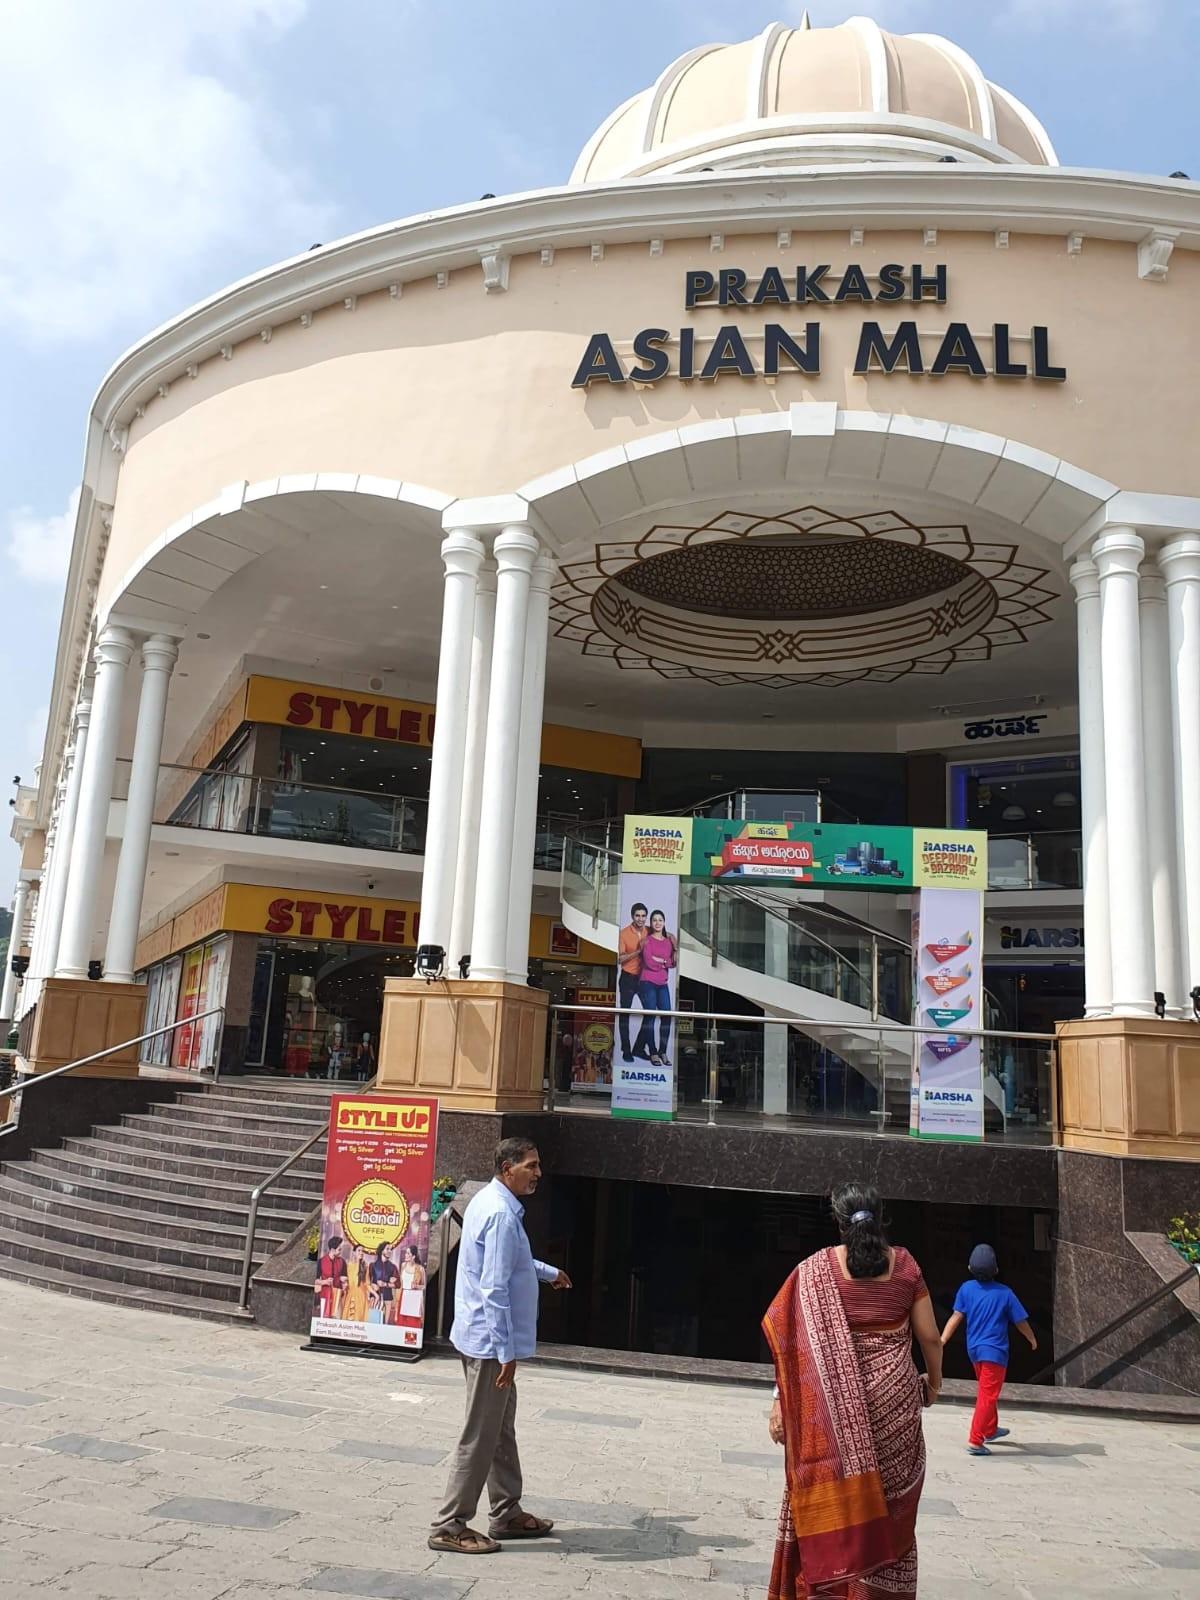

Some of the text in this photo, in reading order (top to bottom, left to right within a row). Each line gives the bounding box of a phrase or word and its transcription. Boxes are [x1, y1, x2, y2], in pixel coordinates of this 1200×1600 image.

[684, 263, 947, 311] PRAKASH
[571, 321, 1067, 388] ASIAN MALL
[286, 692, 422, 743] STYLE
[634, 827, 683, 838] HARSHA
[640, 847, 675, 860] BAZAAR
[923, 841, 975, 853] HARSHA
[931, 863, 968, 876] BAZAAR
[265, 898, 407, 944] STYLE
[1000, 926, 1085, 949] HARS
[621, 1070, 666, 1082] HARSHA
[925, 1091, 973, 1102] HARSHA
[339, 1108, 429, 1129] STYLE UP
[362, 1197, 395, 1213] Sona
[351, 1208, 400, 1226] Chandi
[363, 1227, 385, 1235] OFFER
